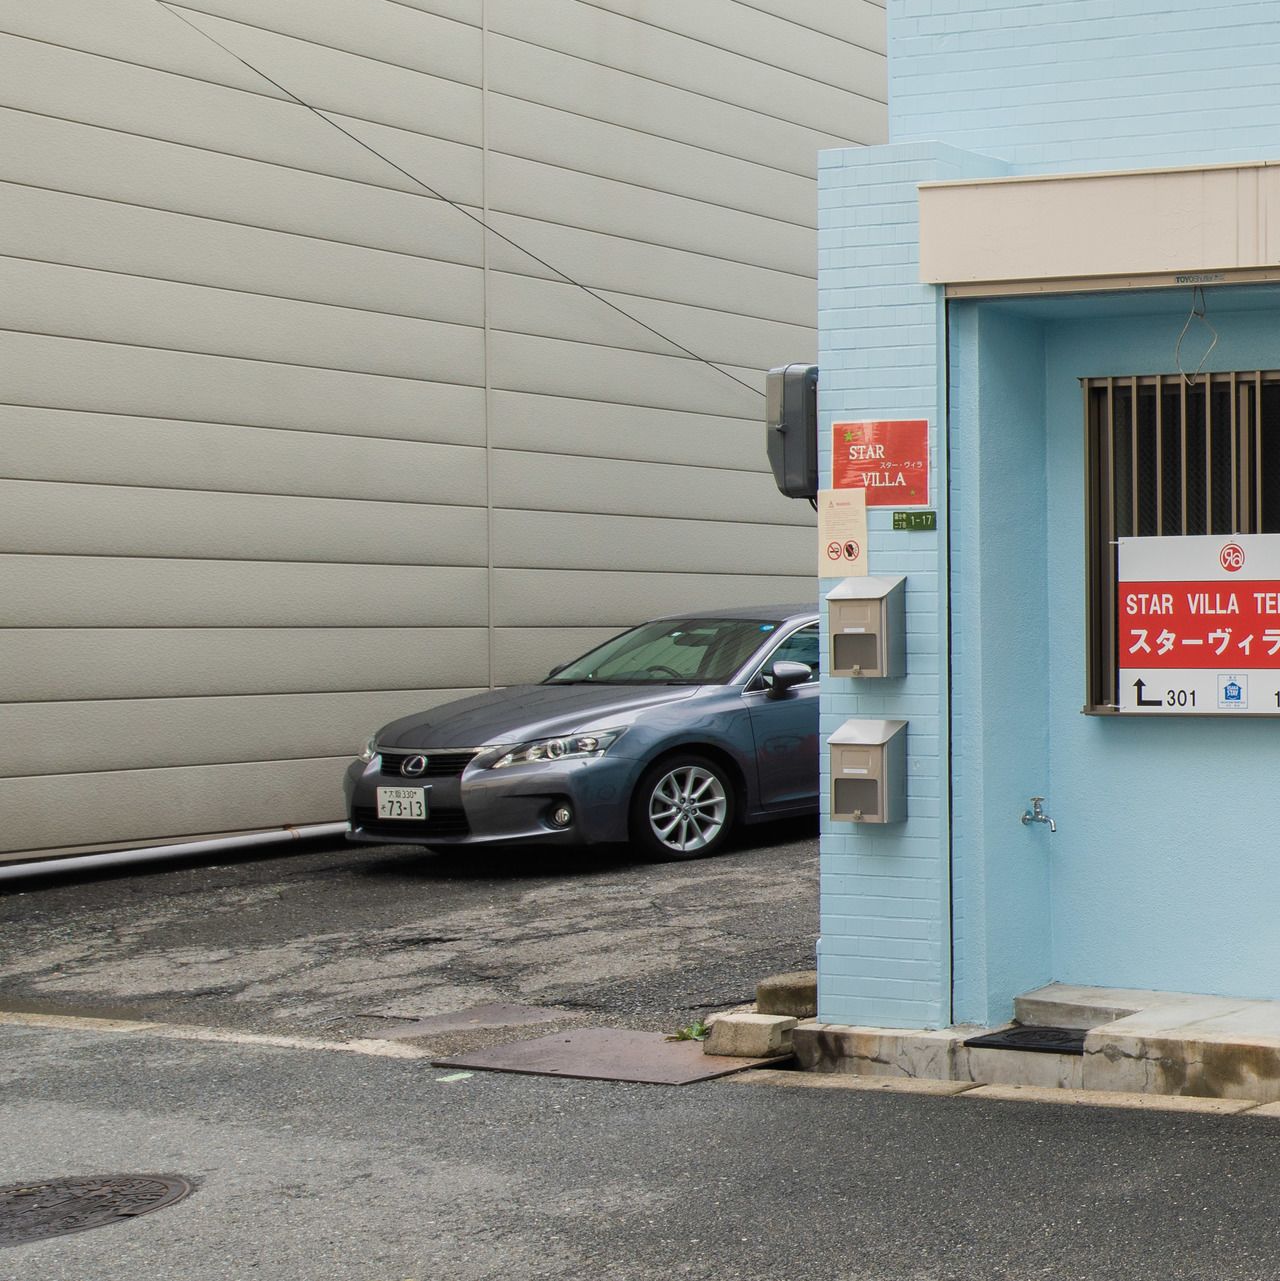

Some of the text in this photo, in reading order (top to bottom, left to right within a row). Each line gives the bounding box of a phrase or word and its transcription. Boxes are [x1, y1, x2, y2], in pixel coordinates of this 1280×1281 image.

[849, 445, 885, 460] STAR
[862, 472, 906, 487] VILLA
[911, 515, 932, 526] 1-17
[1126, 593, 1174, 615] STAR
[1187, 593, 1239, 614] VILLA
[1167, 689, 1196, 707] 301
[388, 800, 423, 817] 73-13
